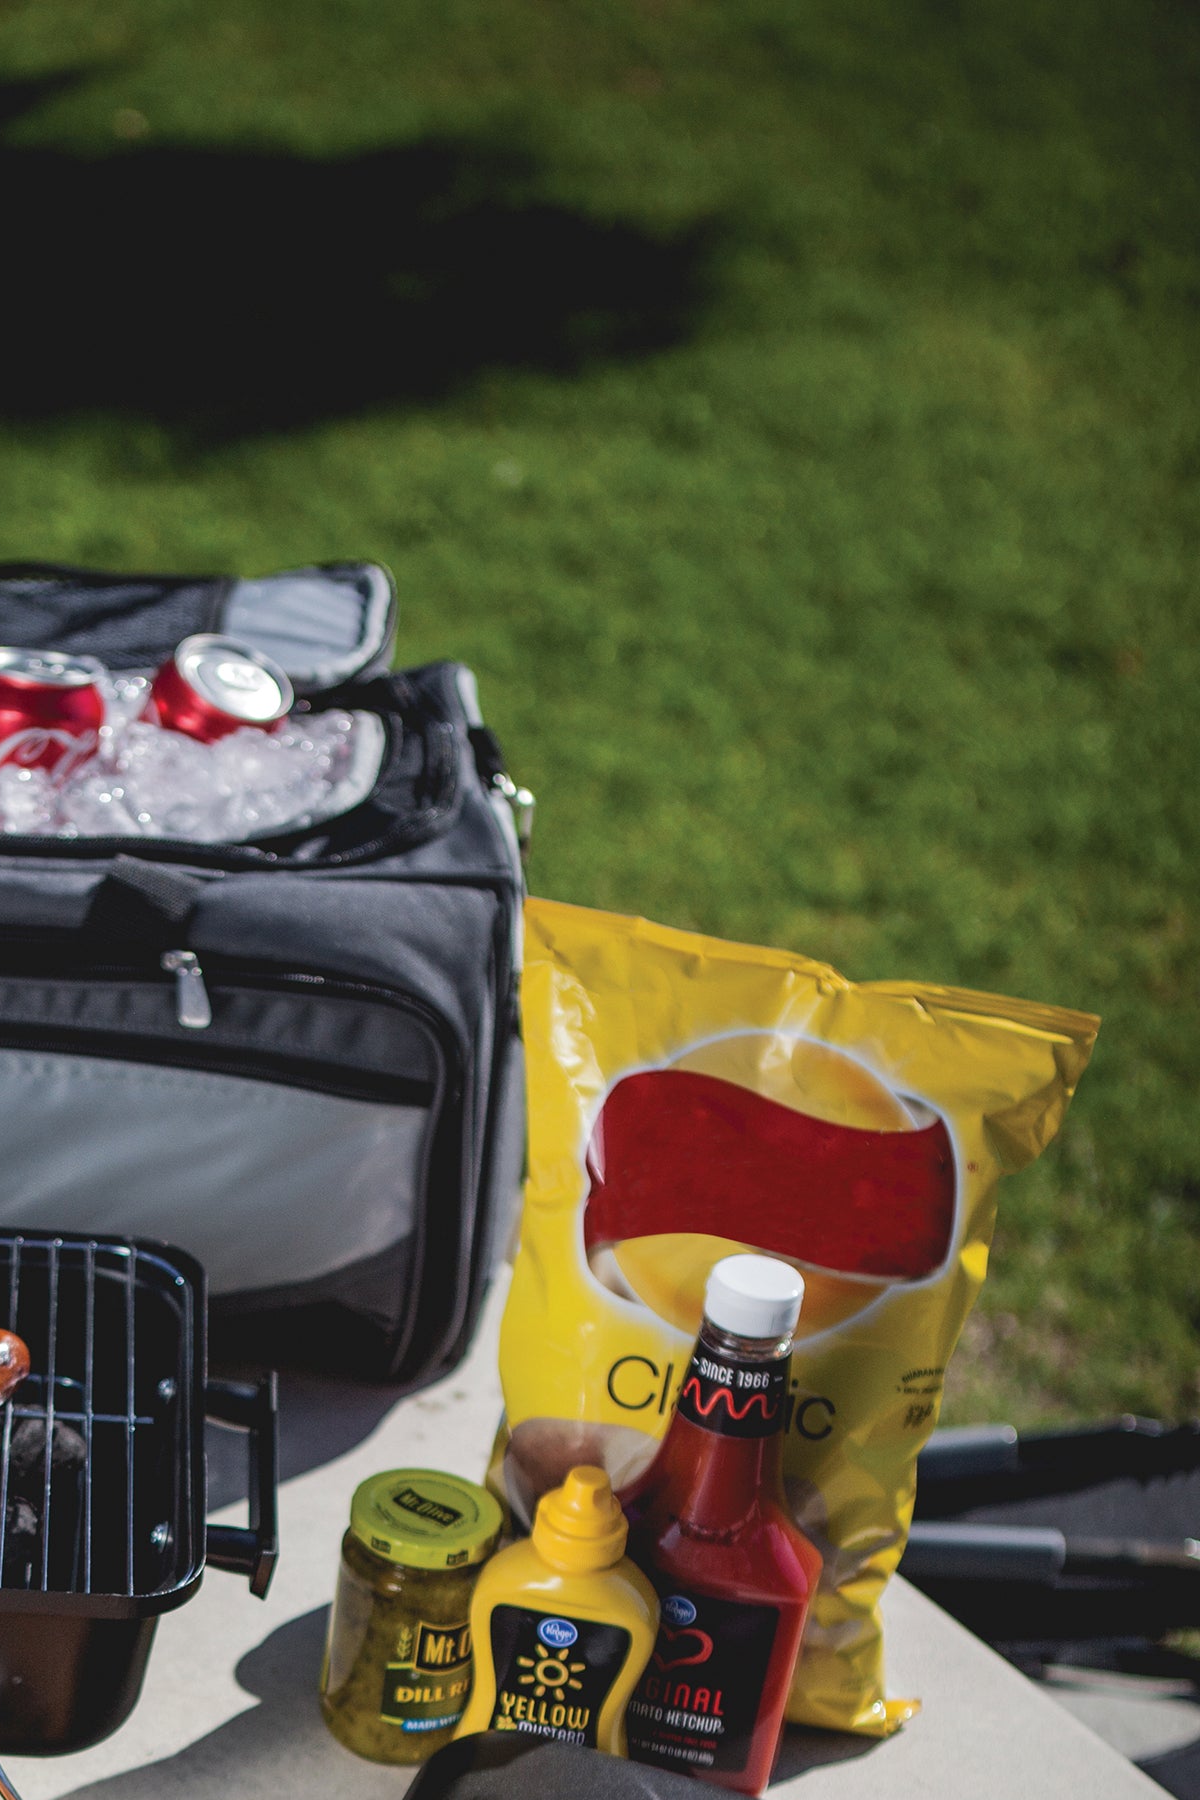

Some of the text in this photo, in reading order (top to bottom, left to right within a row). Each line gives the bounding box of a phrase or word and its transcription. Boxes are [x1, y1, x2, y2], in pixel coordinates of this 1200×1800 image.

[700, 1358, 770, 1389] SINCE 1966
[607, 1354, 837, 1441] Clic
[545, 1623, 573, 1642] Kroger
[425, 1633, 457, 1664] Mt.
[396, 1686, 445, 1703] DILL
[501, 1691, 590, 1730] YELLOW
[666, 1709, 723, 1734] KETCHUP
